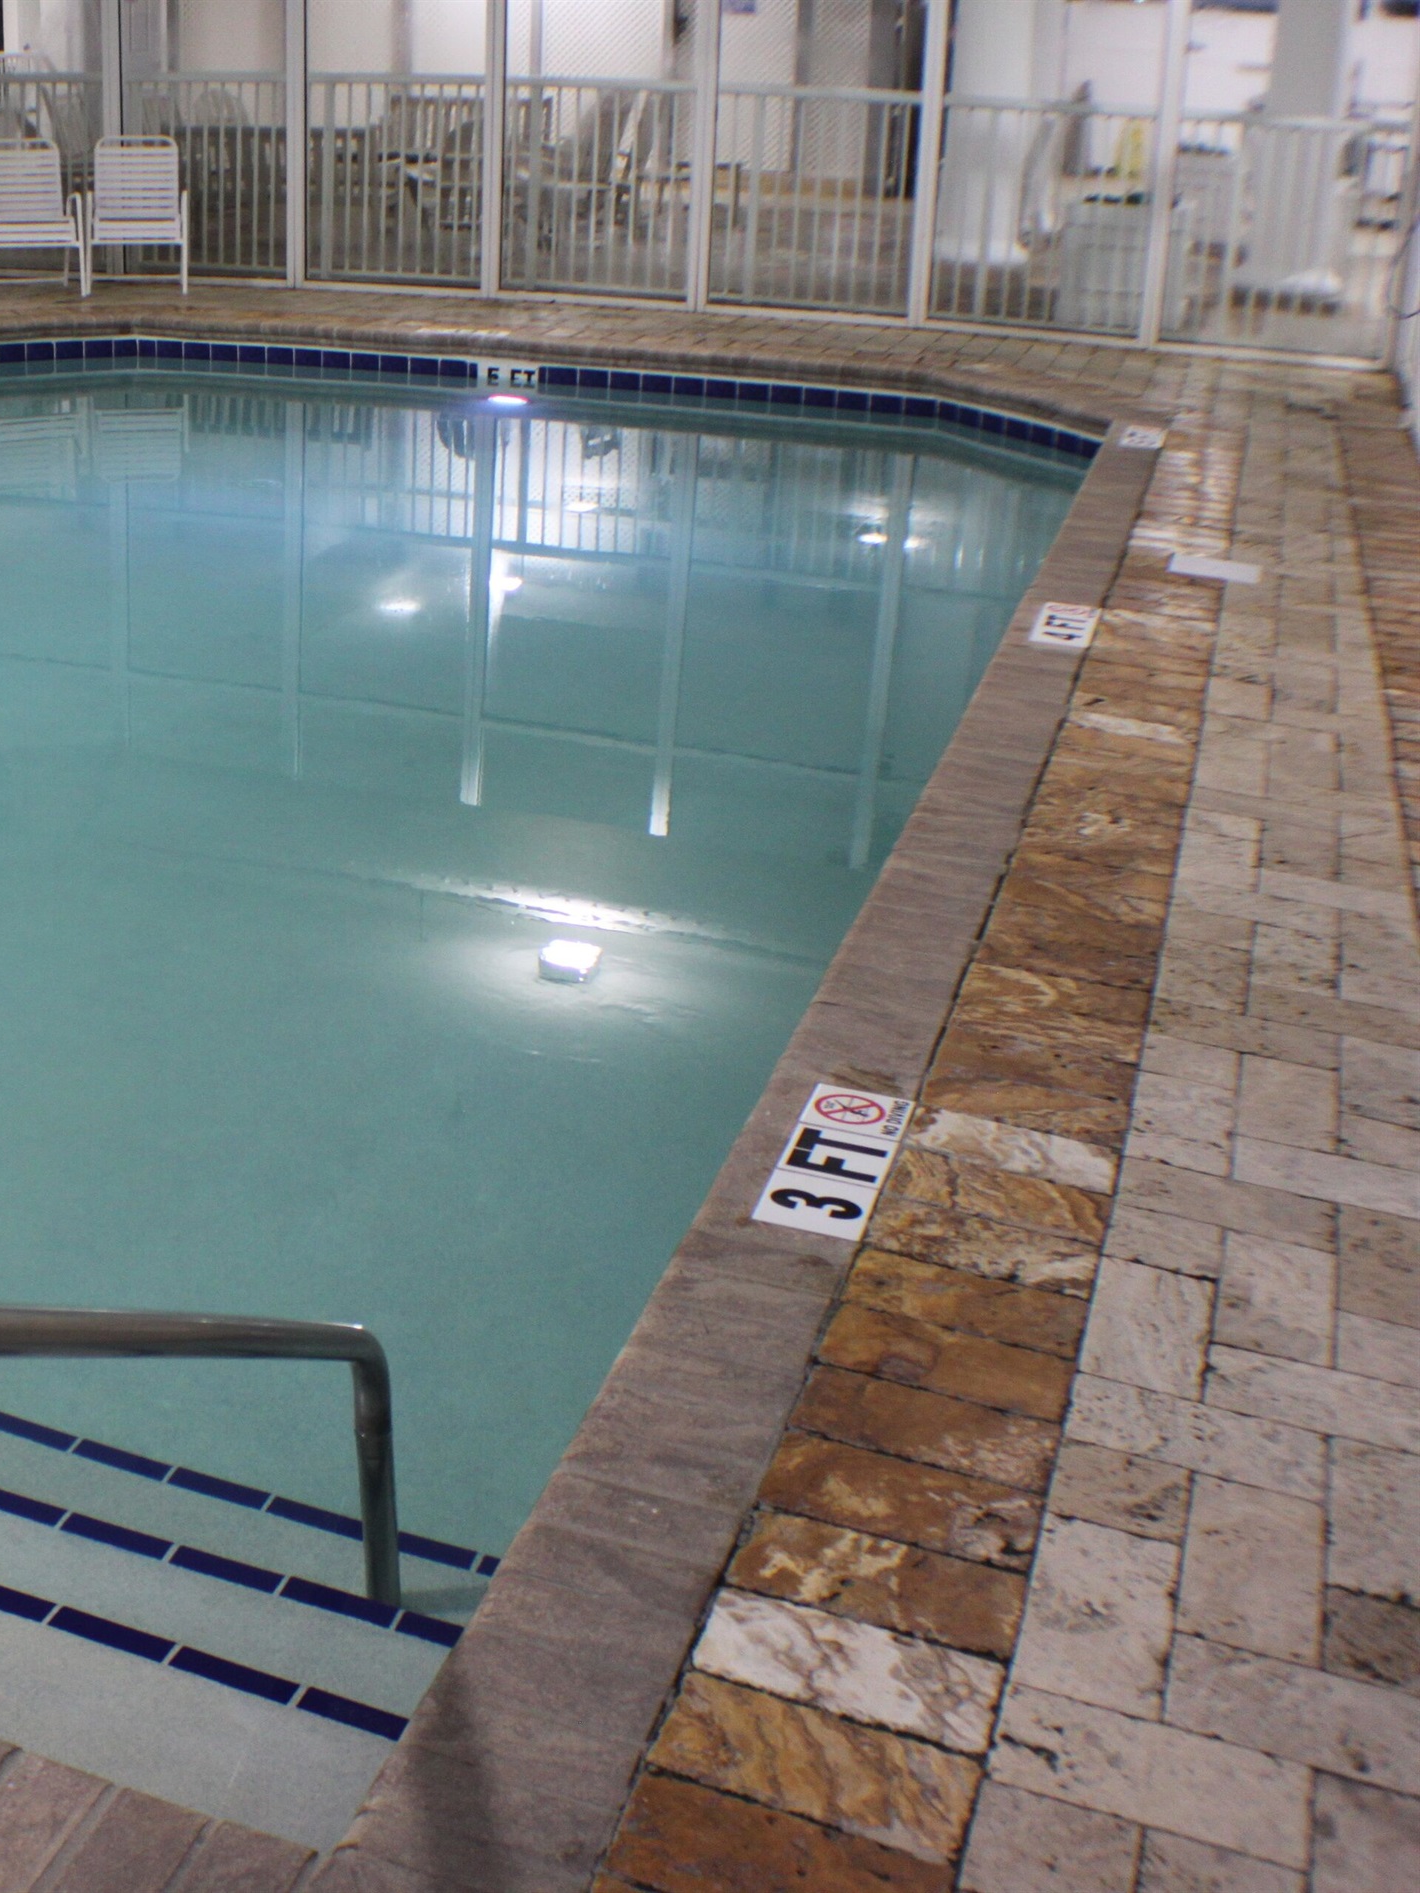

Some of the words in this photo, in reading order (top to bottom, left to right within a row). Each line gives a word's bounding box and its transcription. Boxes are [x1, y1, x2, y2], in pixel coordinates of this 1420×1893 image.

[886, 1100, 910, 1125] DIVING
[880, 1124, 900, 1137] NO
[786, 1127, 888, 1183] FT
[770, 1189, 863, 1220] 3
